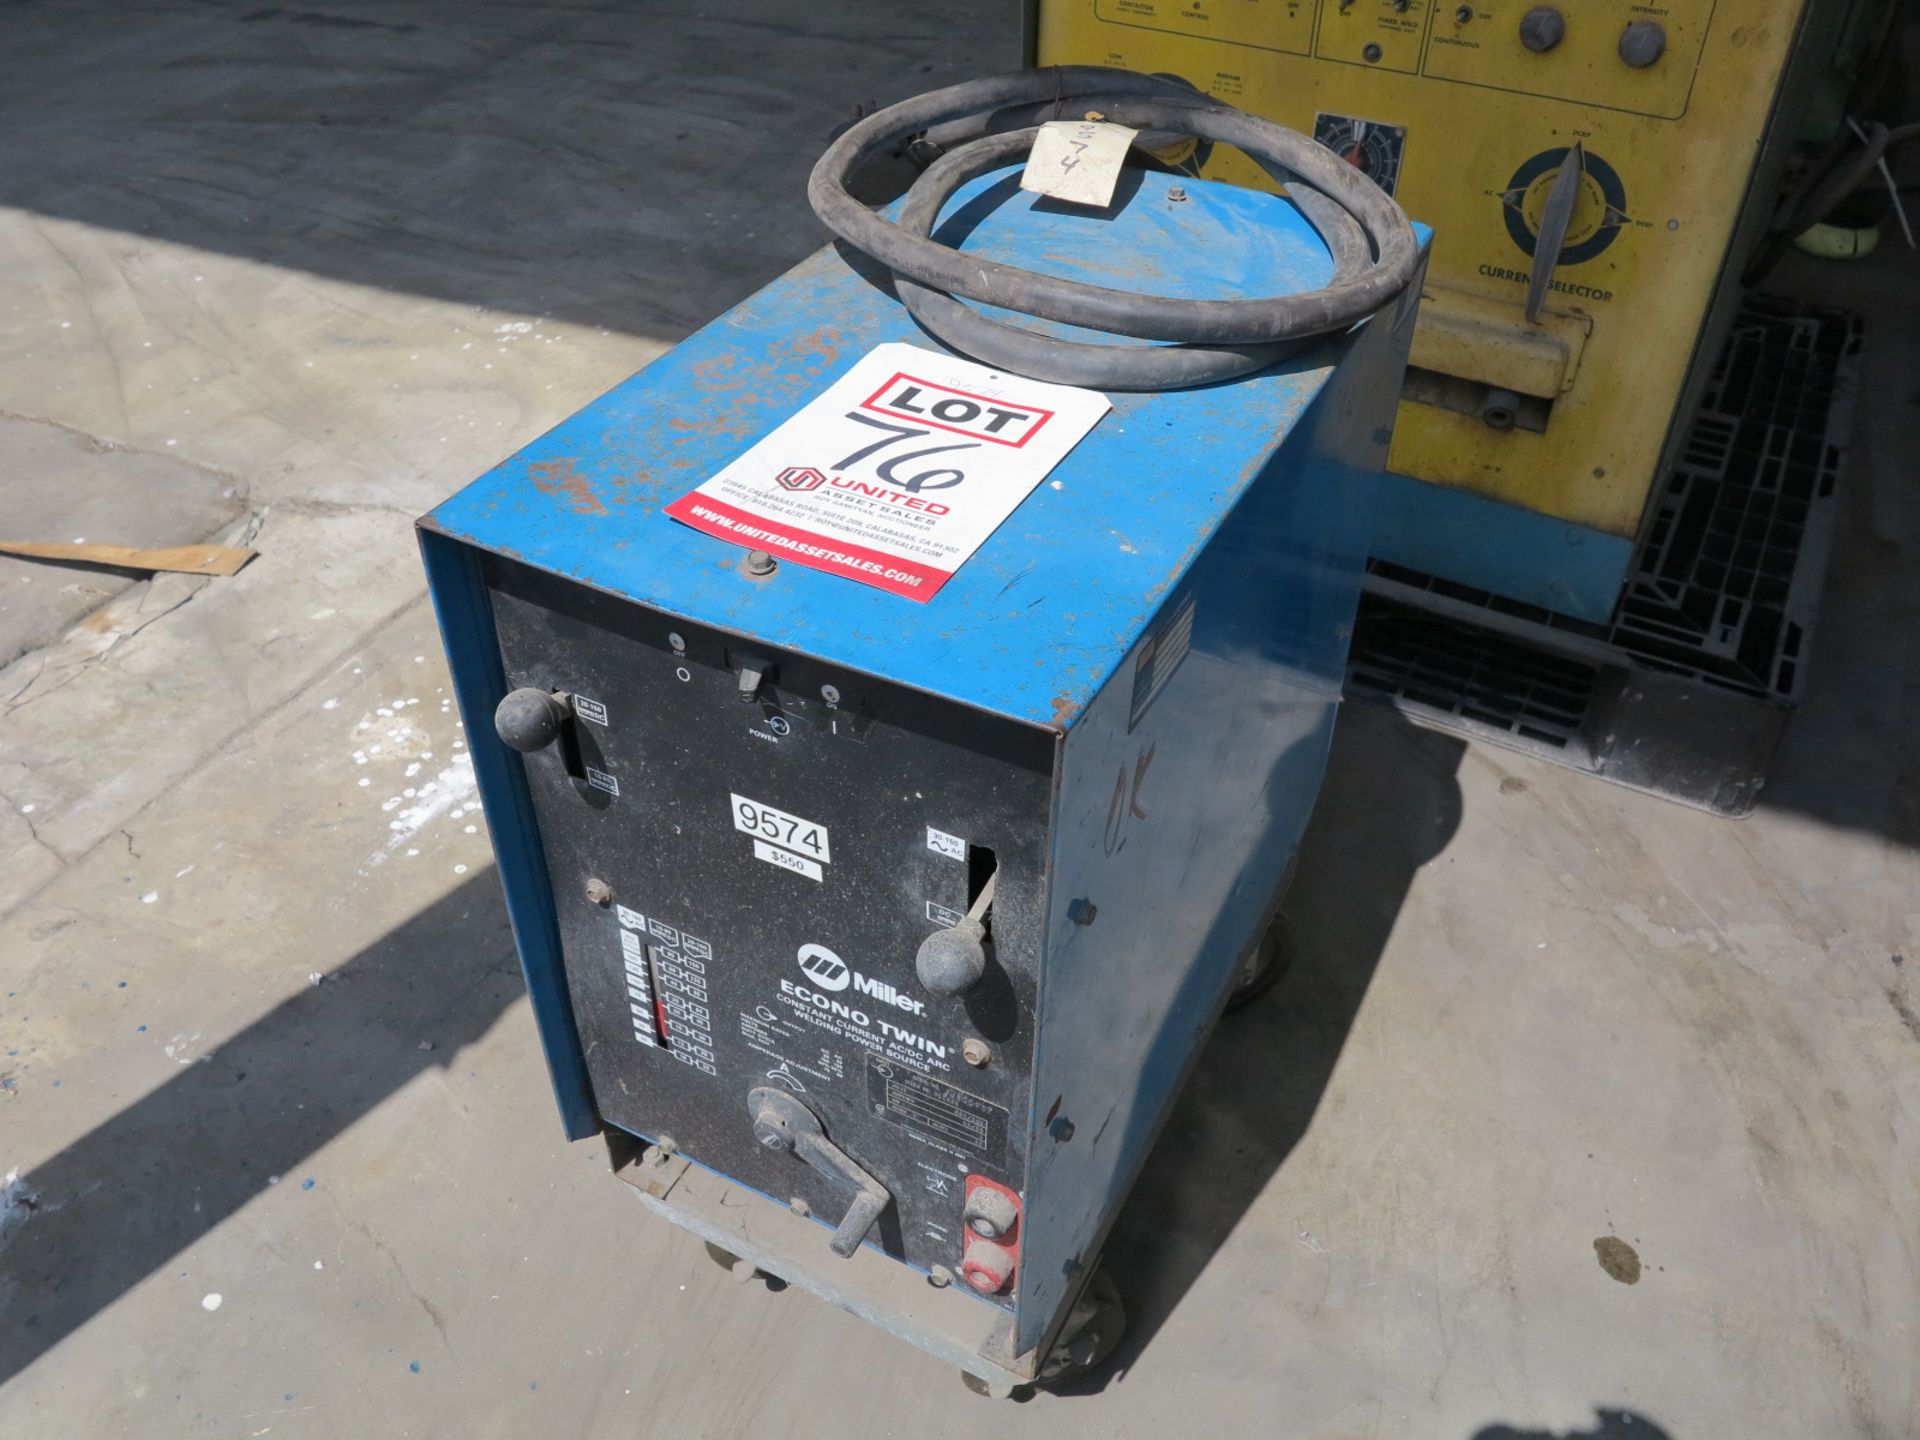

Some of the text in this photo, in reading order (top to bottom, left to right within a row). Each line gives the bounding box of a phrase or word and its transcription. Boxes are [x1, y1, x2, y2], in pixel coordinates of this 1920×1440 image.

[1434, 36, 1480, 49] CONTINUOUS
[1478, 264, 1613, 302] CURREN SELECTOR
[888, 386, 1029, 433] LOT
[830, 411, 982, 494] 76
[814, 494, 830, 503] ROY
[878, 513, 932, 532] AUCTIONEER
[820, 488, 938, 526] ASSET SALES
[830, 476, 951, 516] UNITED
[747, 487, 795, 507] CALABASAS
[822, 510, 847, 521] SUITE
[918, 538, 932, 547] CA
[933, 541, 960, 554] 91302
[690, 504, 923, 588] WWW.UNITEDASSETSALES.COM
[826, 701, 838, 710] ON
[749, 727, 779, 744] POWER
[738, 802, 823, 855] 9574
[771, 850, 805, 872] $550
[951, 847, 963, 857] AC
[853, 971, 925, 1016] Miller
[776, 992, 951, 1073] CONSTANT CURRENT AC/DC ARC
[780, 978, 946, 1059] ECONO TWIN
[781, 1020, 806, 1033] OUTPUT
[793, 1008, 931, 1073] WELDING POWER SOURCE
[747, 1042, 785, 1061] AMPERAGE
[785, 1058, 831, 1082] ADJUSTMENT
[780, 1062, 790, 1074] A
[917, 1161, 957, 1182] ELECTRODE
[926, 1220, 948, 1233] WORK
